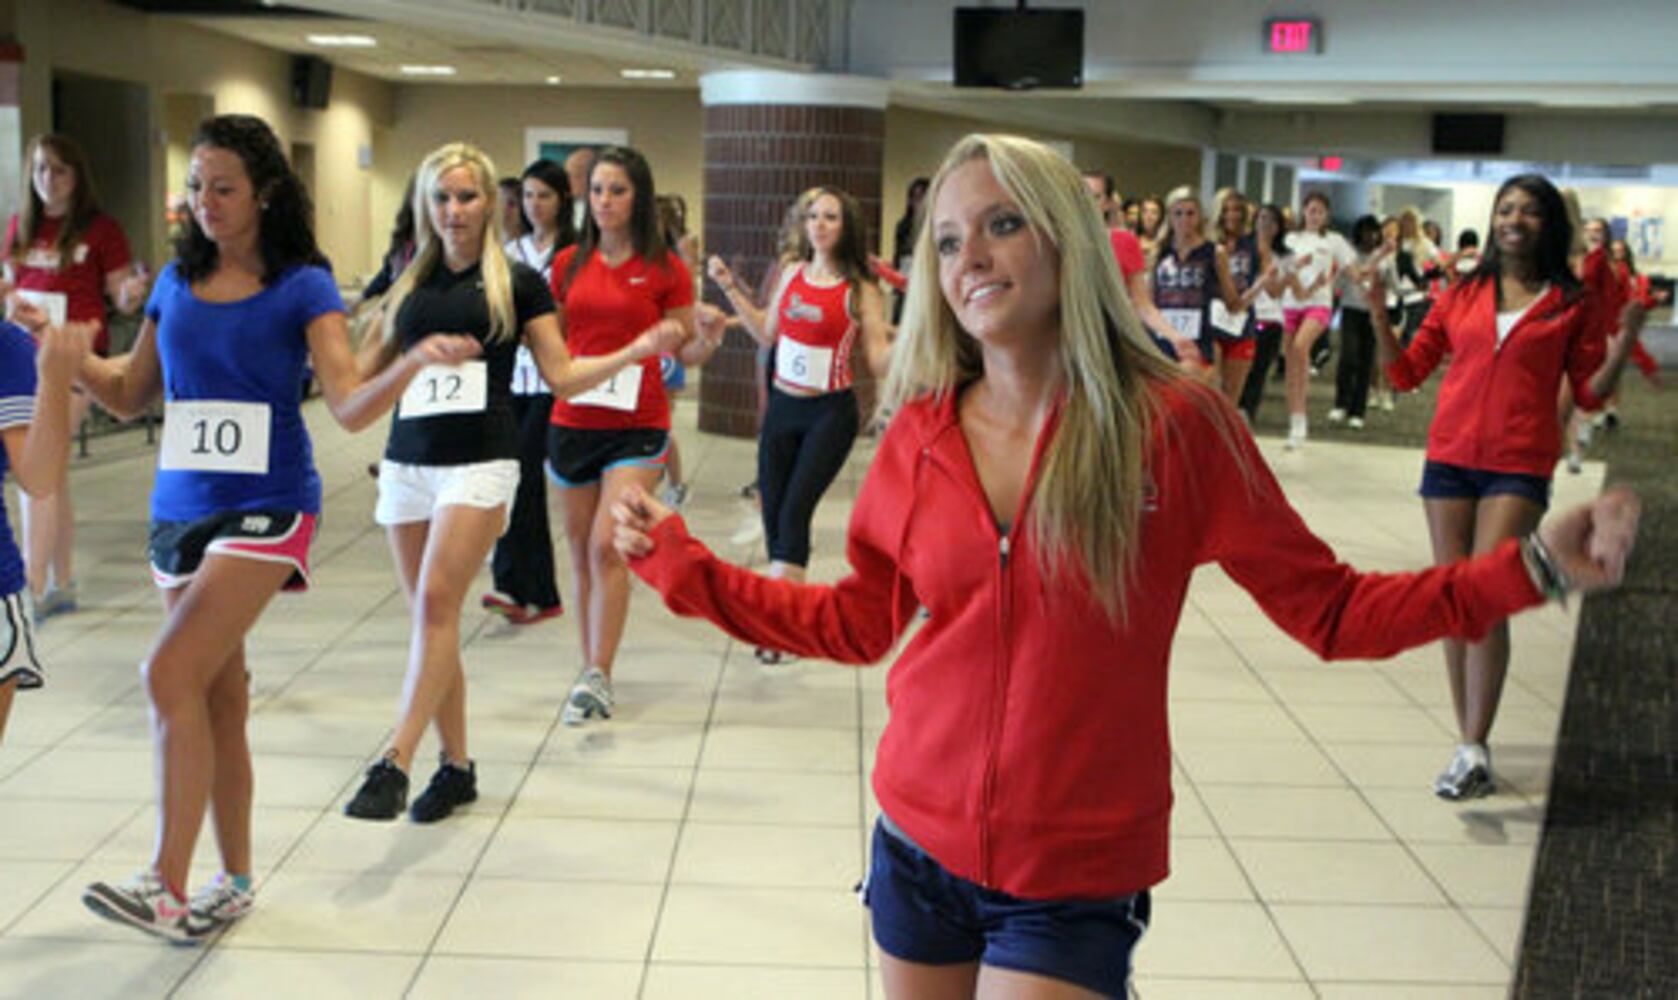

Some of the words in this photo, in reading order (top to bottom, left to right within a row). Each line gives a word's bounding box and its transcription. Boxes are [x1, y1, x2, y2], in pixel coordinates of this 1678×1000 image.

[1271, 22, 1311, 51] EXIT
[792, 355, 806, 377] 6
[427, 374, 462, 403] 12
[191, 419, 242, 456] 10
